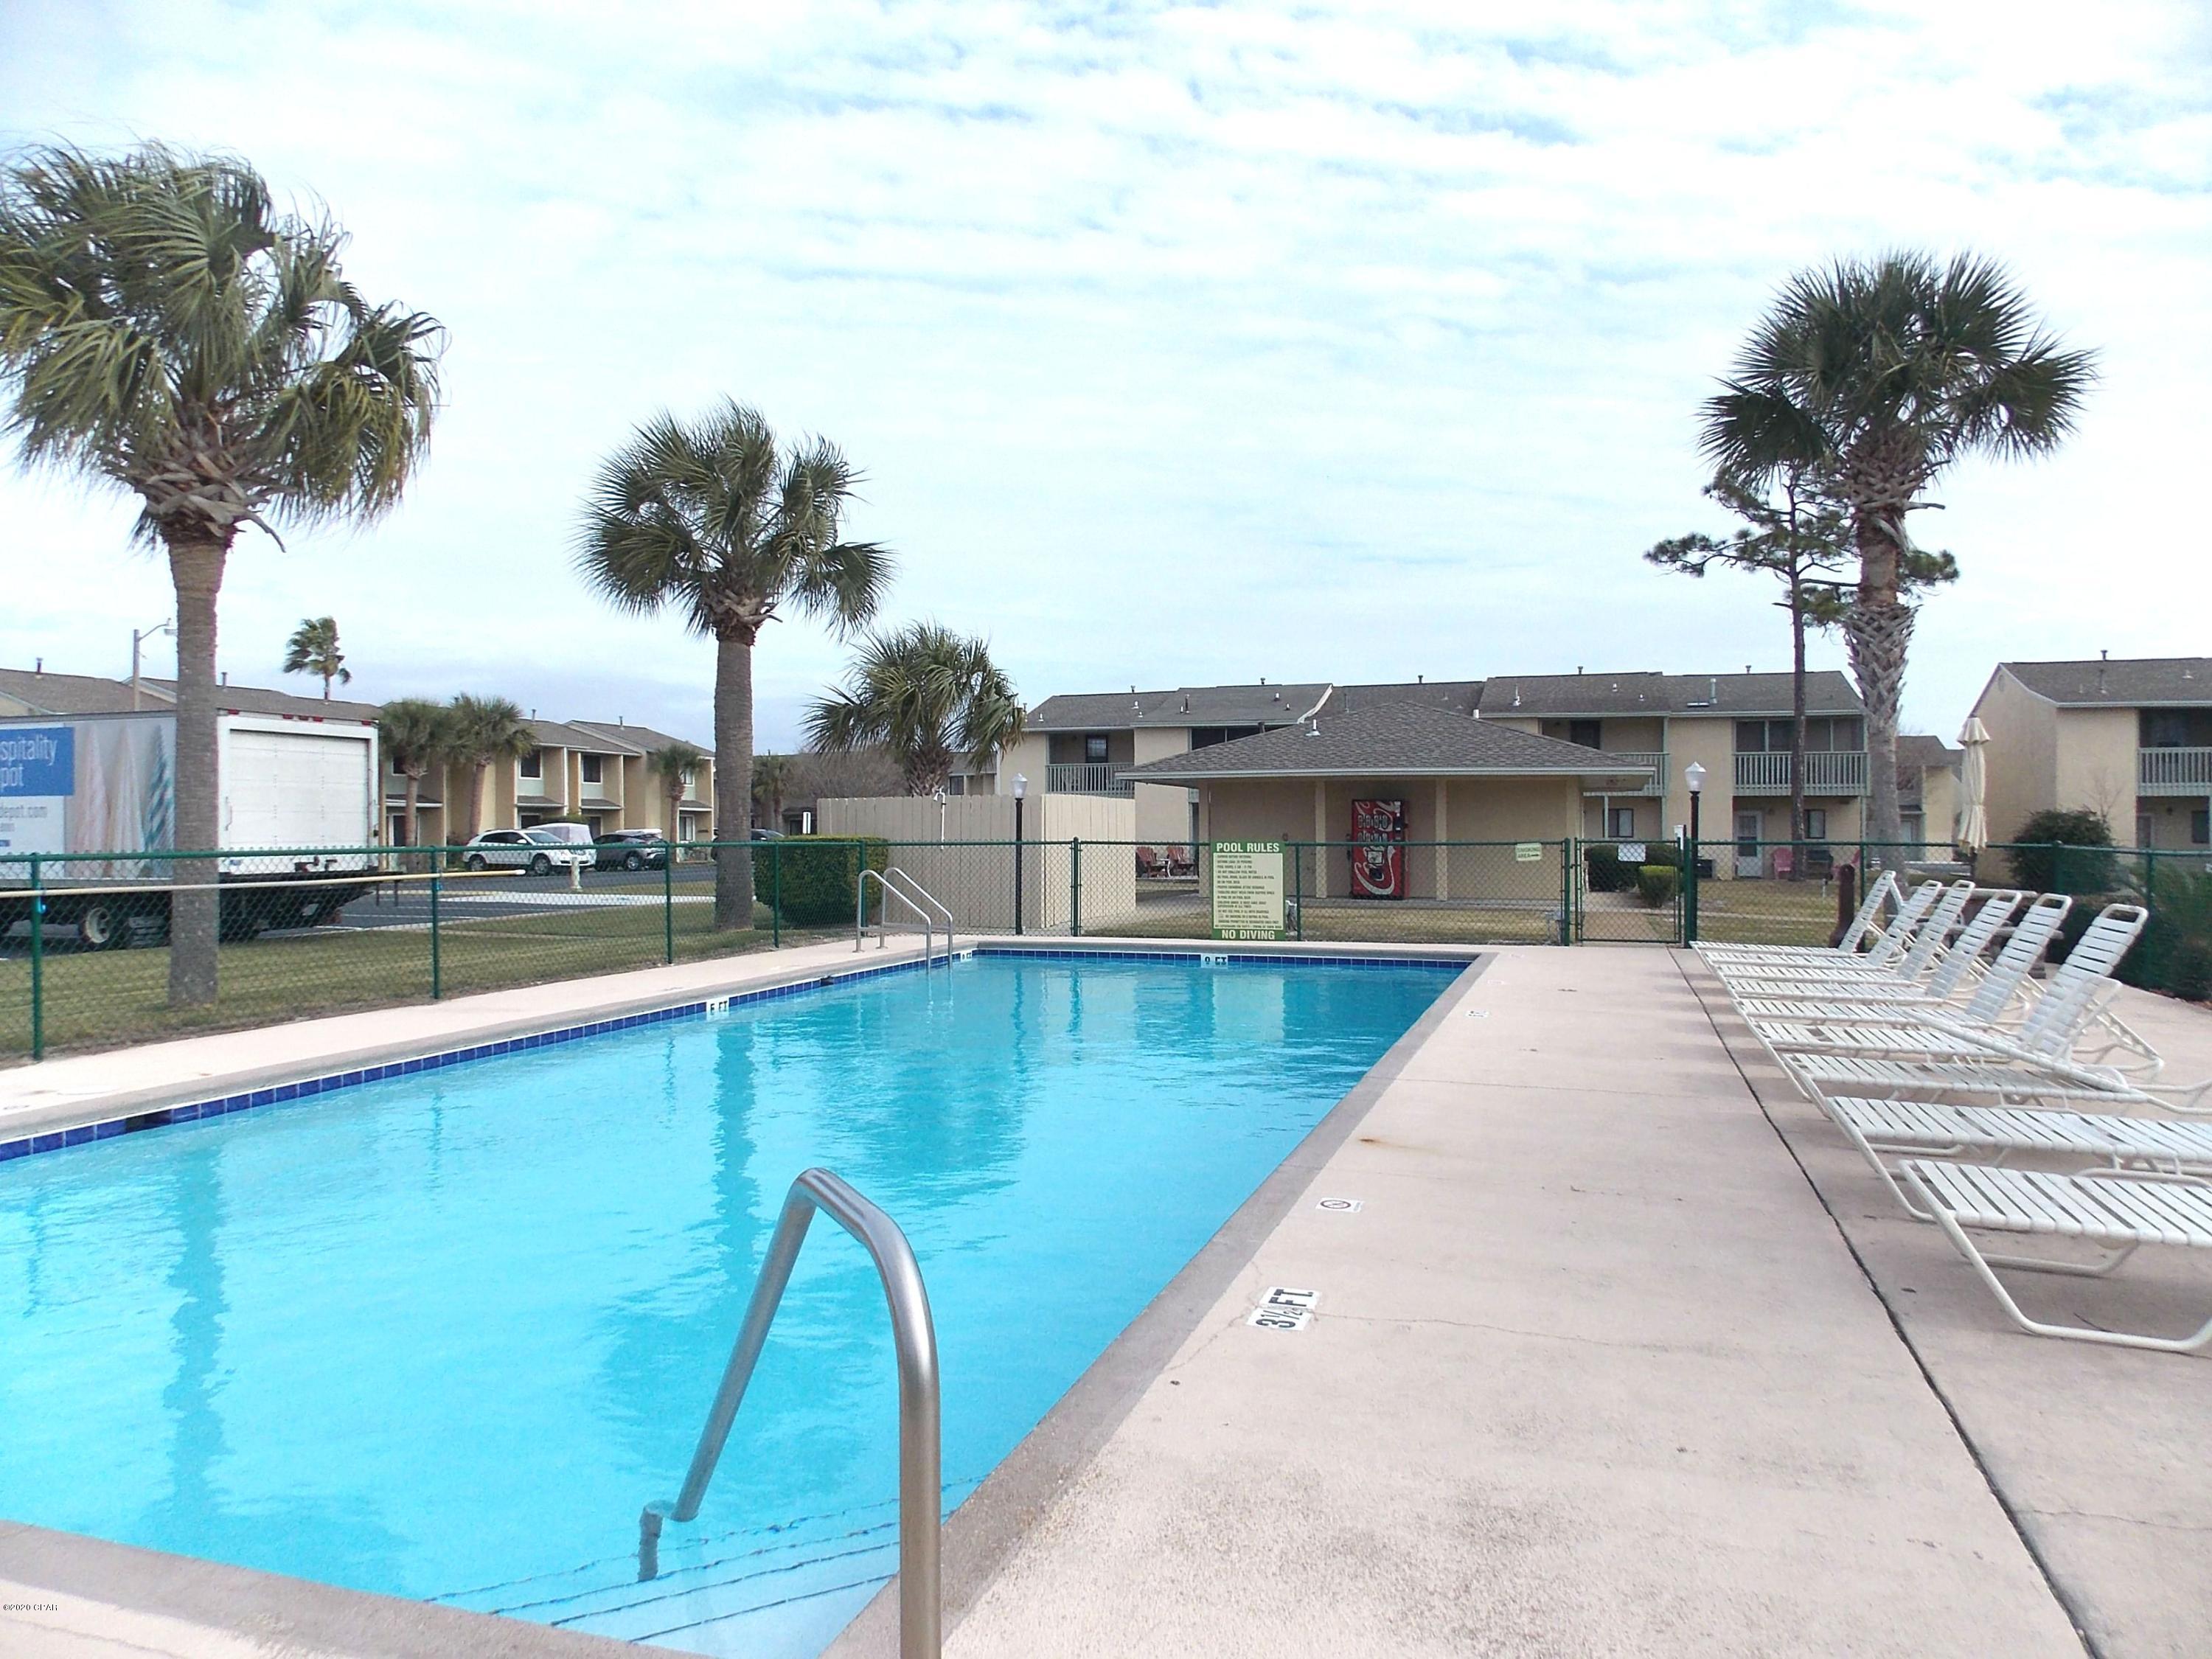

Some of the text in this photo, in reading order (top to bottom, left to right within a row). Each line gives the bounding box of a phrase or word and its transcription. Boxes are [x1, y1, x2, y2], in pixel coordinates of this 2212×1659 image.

[1216, 842, 1280, 852] POOL RULES
[1221, 929, 1275, 940] NO DIVING
[1268, 1289, 1314, 1307] FT
